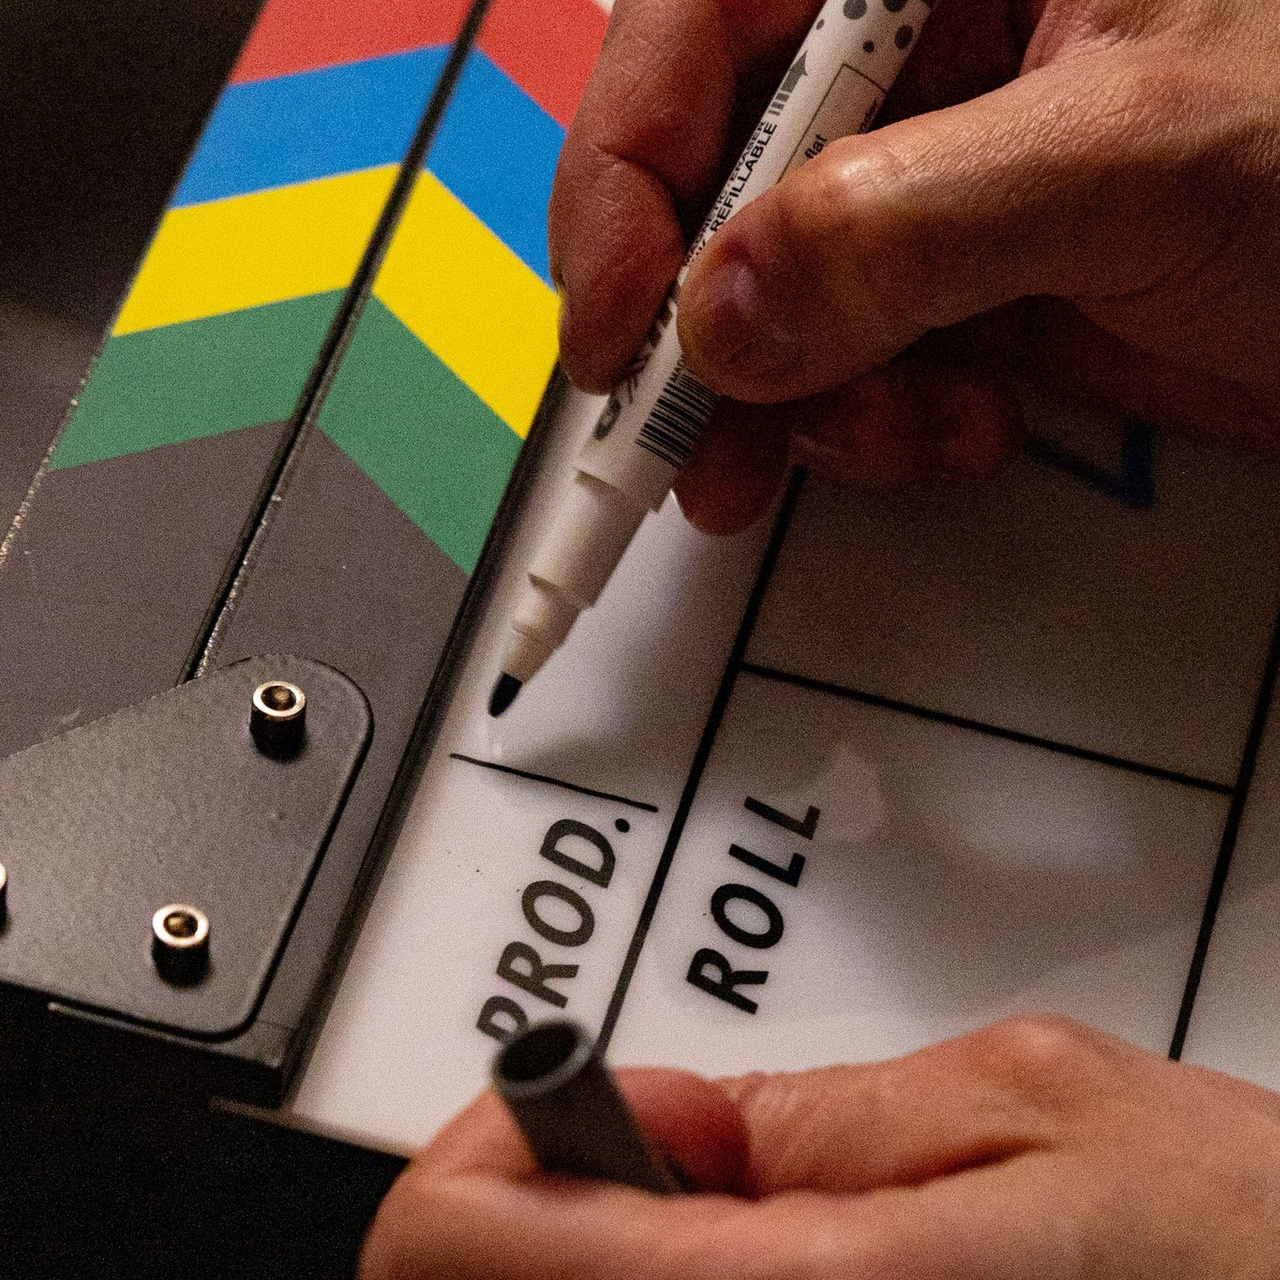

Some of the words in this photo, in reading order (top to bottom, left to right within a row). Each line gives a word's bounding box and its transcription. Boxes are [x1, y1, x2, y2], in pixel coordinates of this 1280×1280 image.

[709, 120, 777, 234] REFILLABLE
[475, 818, 630, 1043] PROD.
[686, 795, 821, 1015] ROLL
